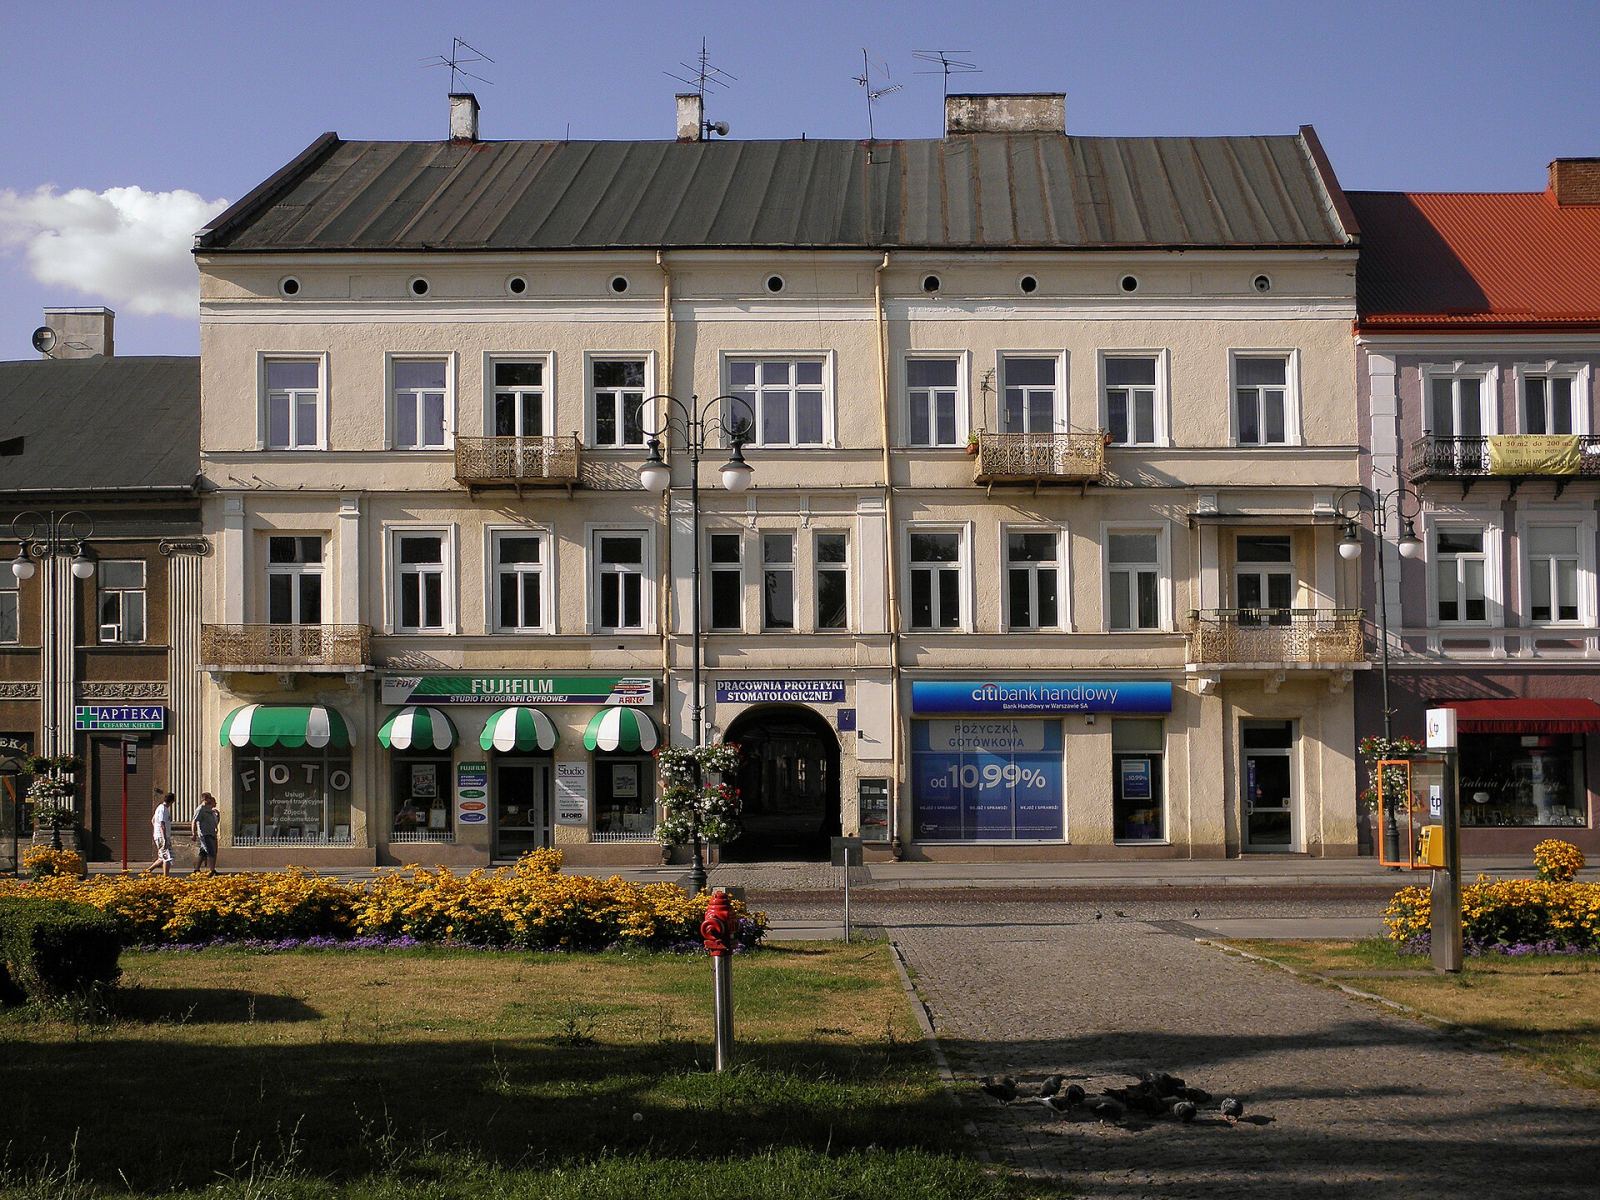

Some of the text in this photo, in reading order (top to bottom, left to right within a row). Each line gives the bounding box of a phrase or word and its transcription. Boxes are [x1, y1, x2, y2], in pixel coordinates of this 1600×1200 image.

[471, 679, 553, 694] FUJIFILM
[717, 680, 843, 691] PRACOWNIA PROTETYKI
[450, 695, 479, 703] STUDIO
[727, 691, 833, 701] STOMATOLOGICZNEJ
[972, 683, 1118, 704] citibank handlowy
[100, 708, 161, 720] APTEKA
[954, 723, 1019, 734] POŻYCZKA
[948, 736, 1024, 747] GOTÓWKOWA
[558, 766, 585, 776] Studio
[240, 763, 351, 791] FOTO
[930, 764, 1046, 791] od 10,99%
[284, 791, 305, 800] Usługi
[1430, 795, 1441, 811] tp
